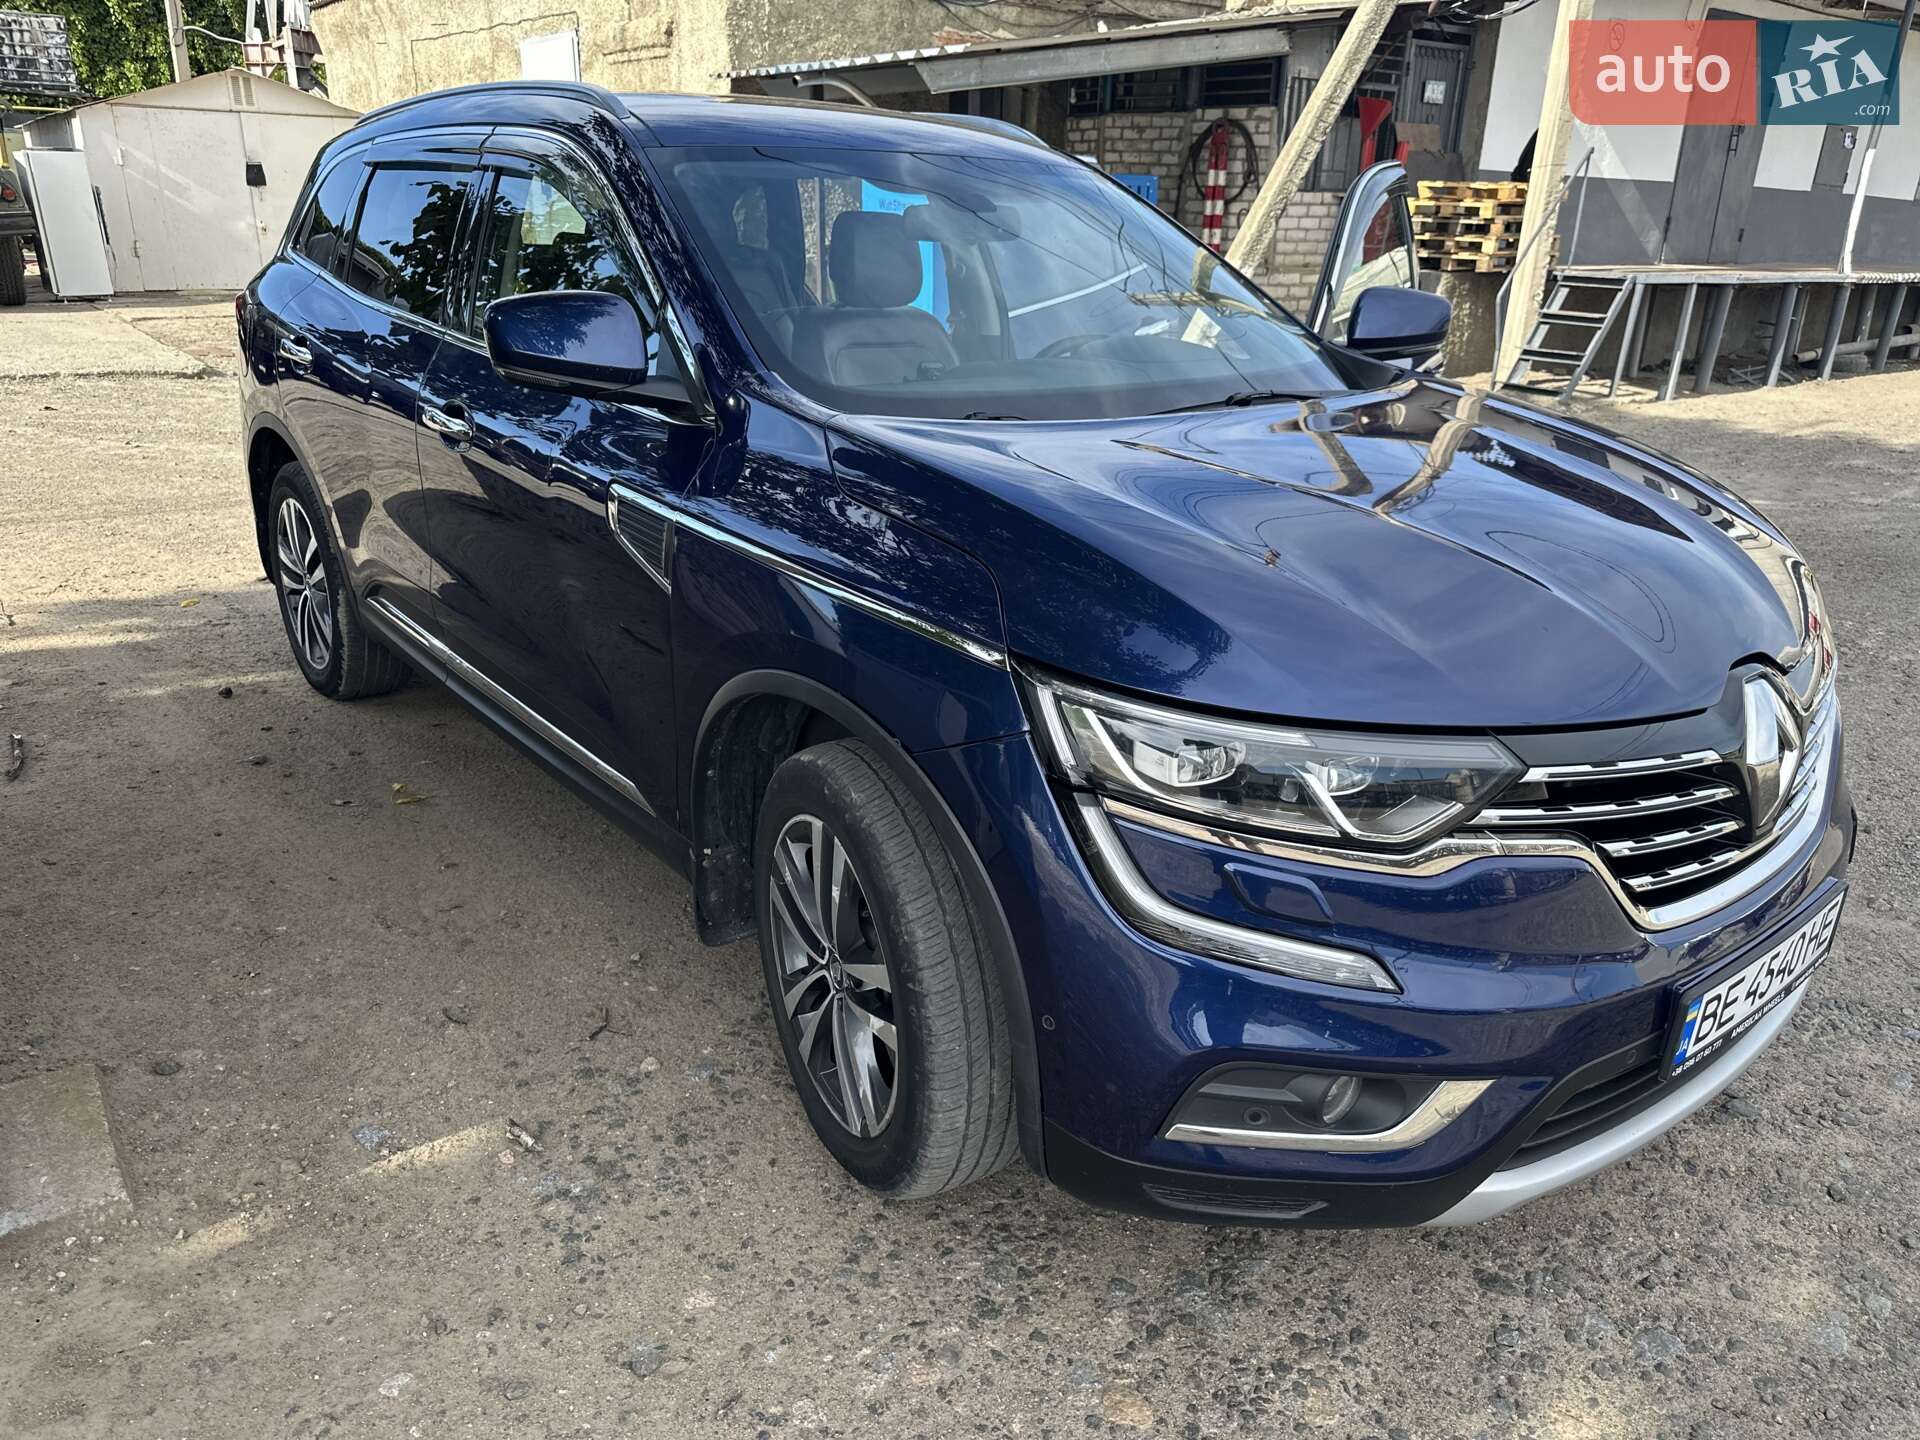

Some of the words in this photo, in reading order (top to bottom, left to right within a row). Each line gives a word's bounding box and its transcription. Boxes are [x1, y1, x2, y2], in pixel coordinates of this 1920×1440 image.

[1692, 974, 1746, 1048] BE
[1744, 931, 1806, 1007] 4540
[1801, 901, 1841, 964] HE
[1730, 1008, 1763, 1040] AMERICAN
[1762, 990, 1786, 1015] WHEELS
